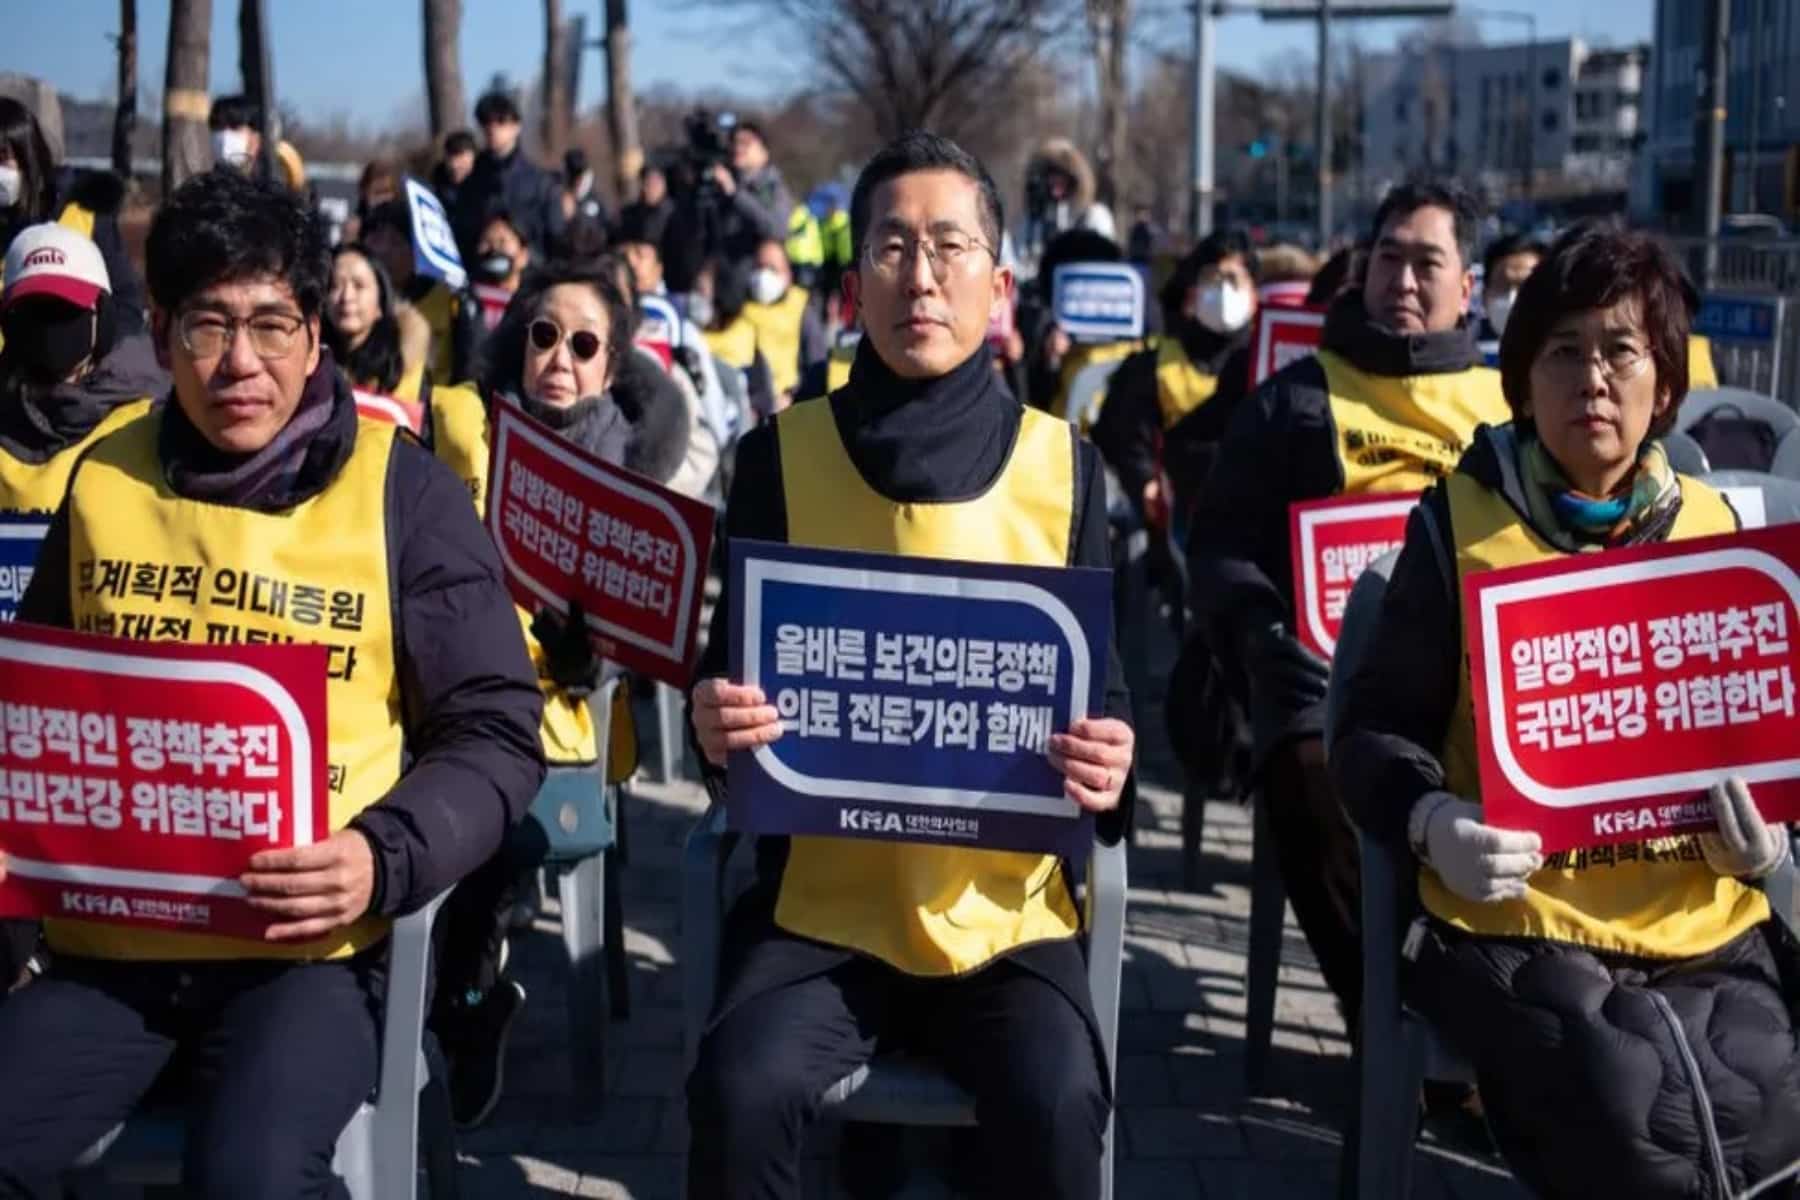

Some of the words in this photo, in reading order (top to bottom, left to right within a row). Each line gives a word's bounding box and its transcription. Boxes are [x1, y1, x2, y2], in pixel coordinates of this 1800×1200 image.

[508, 458, 584, 535] 일방적인
[587, 507, 679, 577] 정책추진
[504, 500, 579, 576] 국민건강
[582, 550, 673, 618] 위협한다
[210, 567, 365, 632] 의대증원
[775, 623, 867, 681] 올바른
[872, 631, 1059, 696] 보건의료정책
[1511, 623, 1643, 692] 일방적인
[1648, 601, 1788, 670] 정책추진
[0, 703, 119, 768] 방적인
[126, 717, 280, 778] 정책추진
[776, 687, 841, 738] 의료
[848, 693, 980, 751] 전문가와
[986, 701, 1054, 756] 함께
[1515, 685, 1648, 751] 국민건강
[1655, 665, 1796, 732] 위협한다
[0, 768, 123, 830] 민건강
[131, 781, 282, 843] 위협한다
